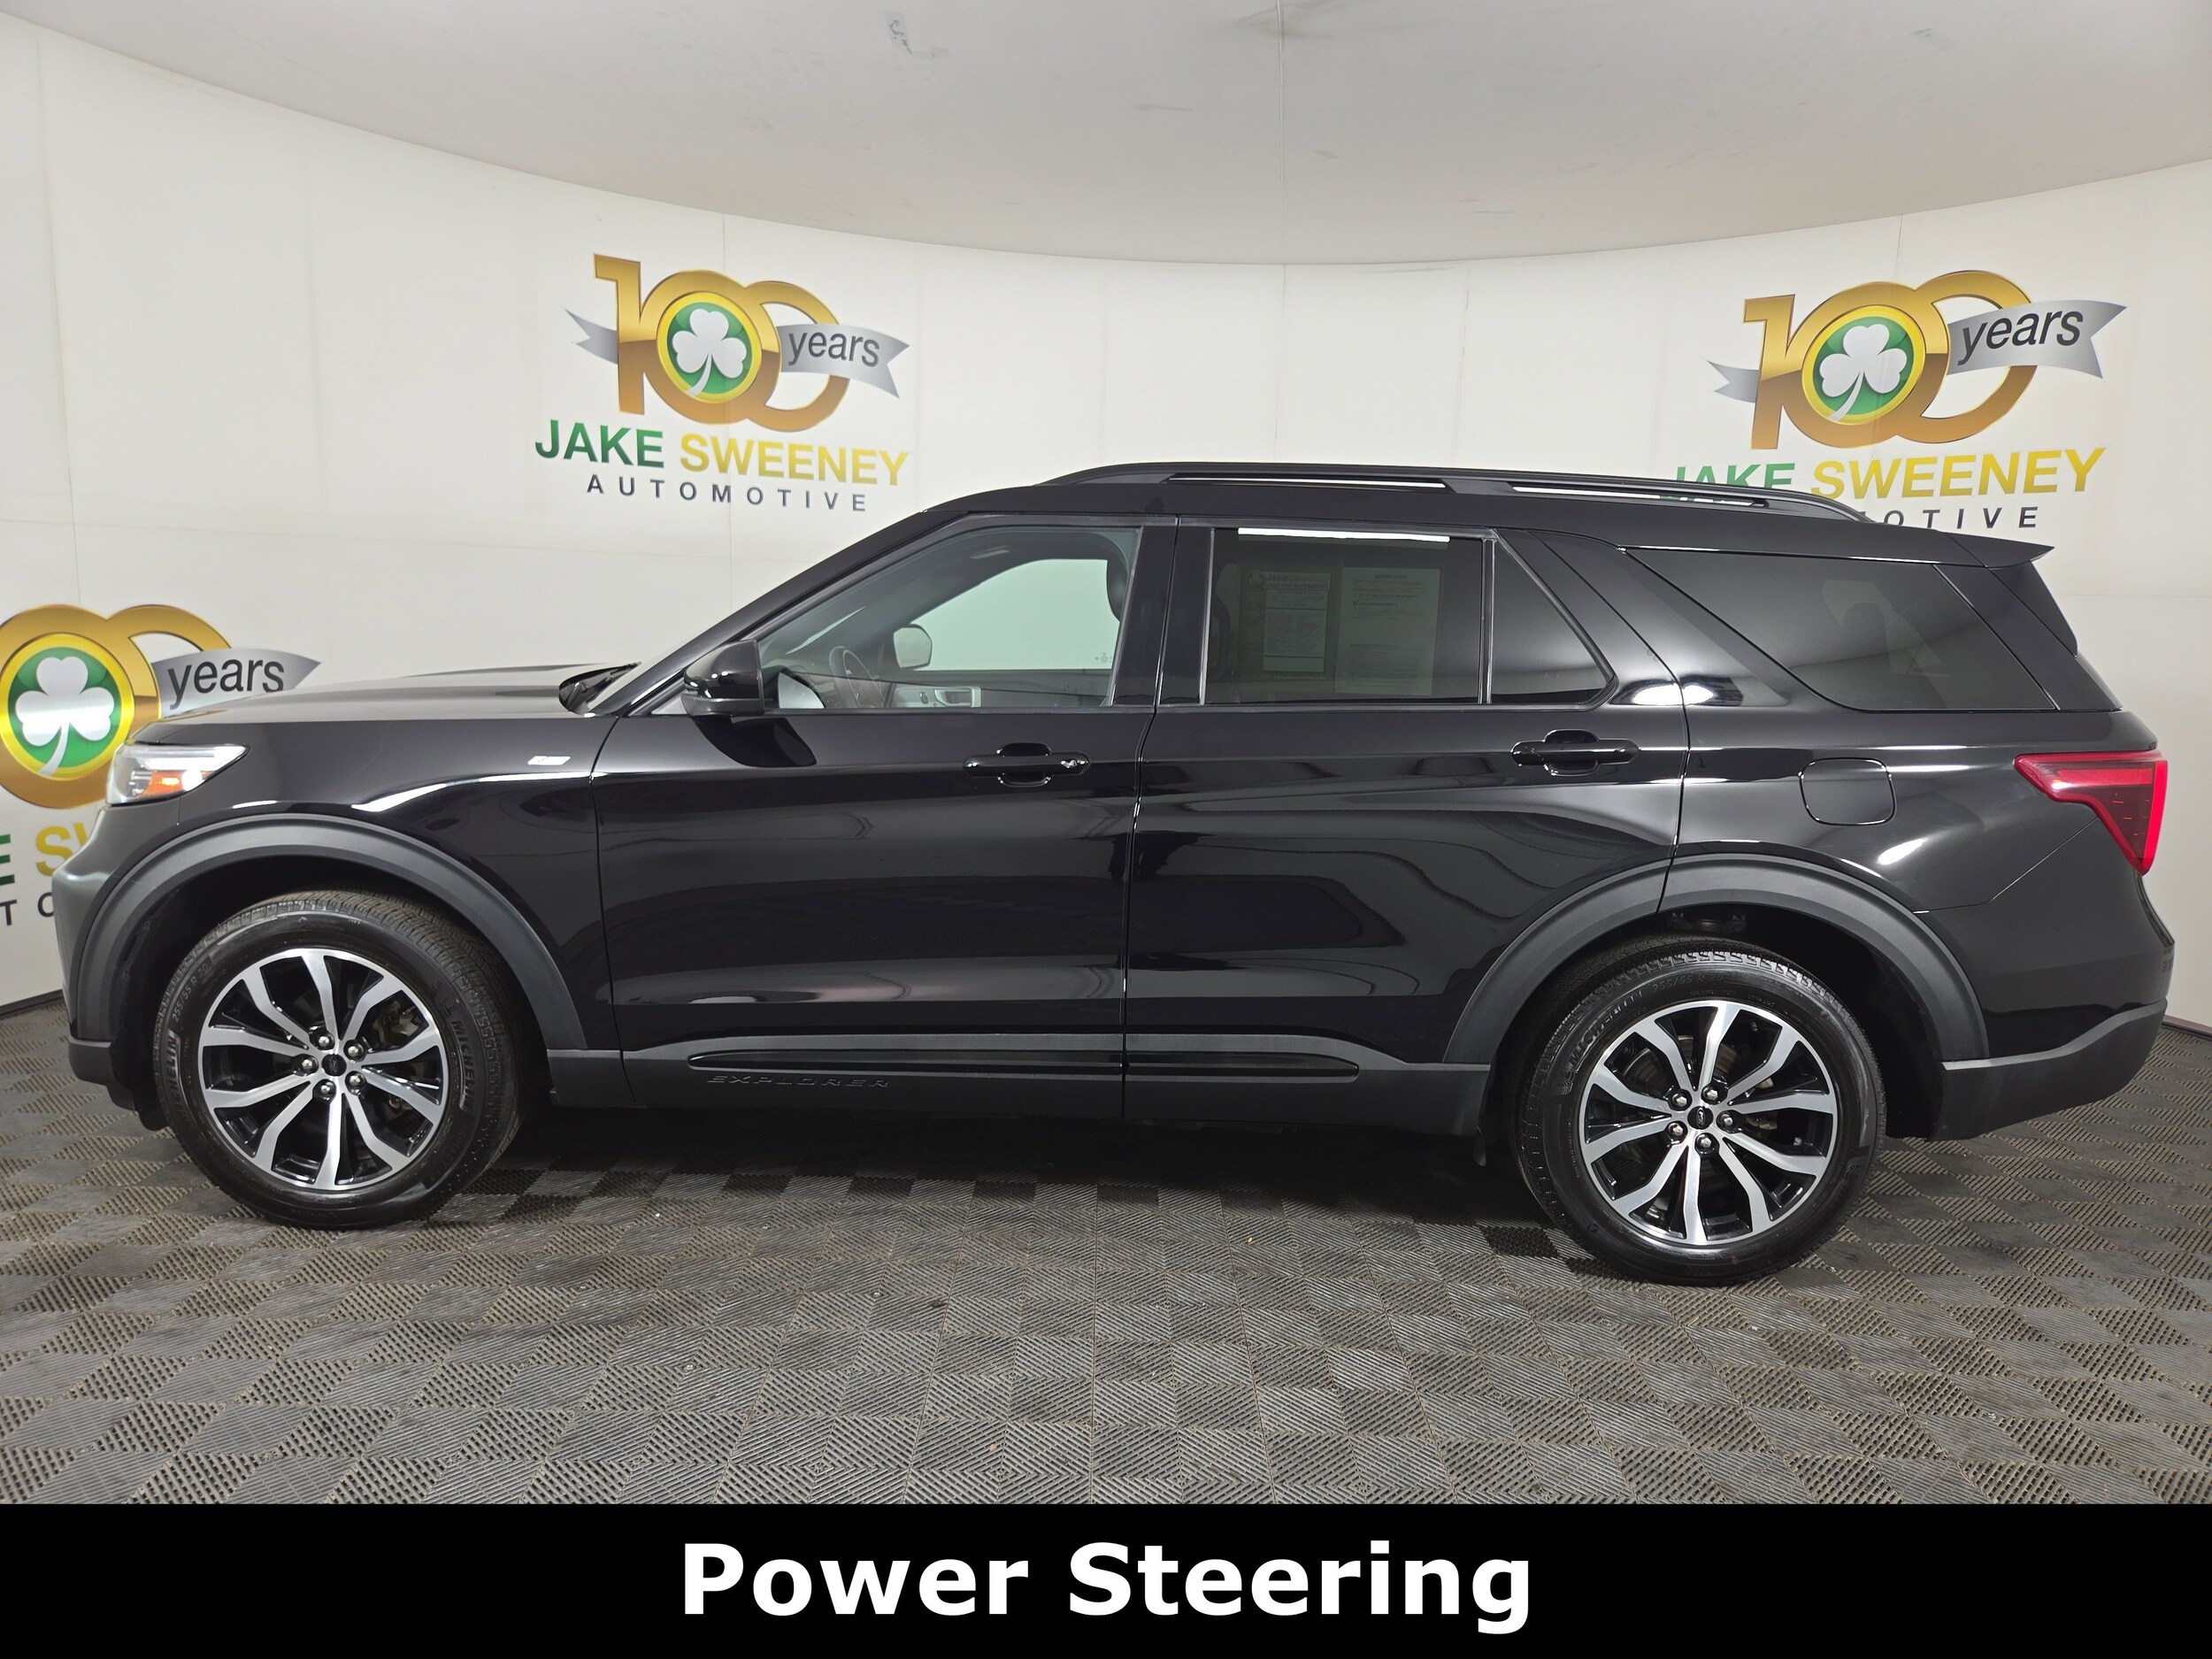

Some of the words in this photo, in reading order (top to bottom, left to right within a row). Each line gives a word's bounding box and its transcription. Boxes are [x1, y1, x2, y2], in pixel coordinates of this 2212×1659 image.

[787, 331, 880, 367] years
[1958, 310, 2084, 366] years
[534, 419, 664, 469] JAKE
[680, 434, 909, 486] SWEENEY
[1810, 447, 2108, 500] SWEENEY
[587, 473, 866, 511] AUTOMOTIVE
[167, 658, 285, 710] years
[706, 1074, 893, 1088] EXPLORER
